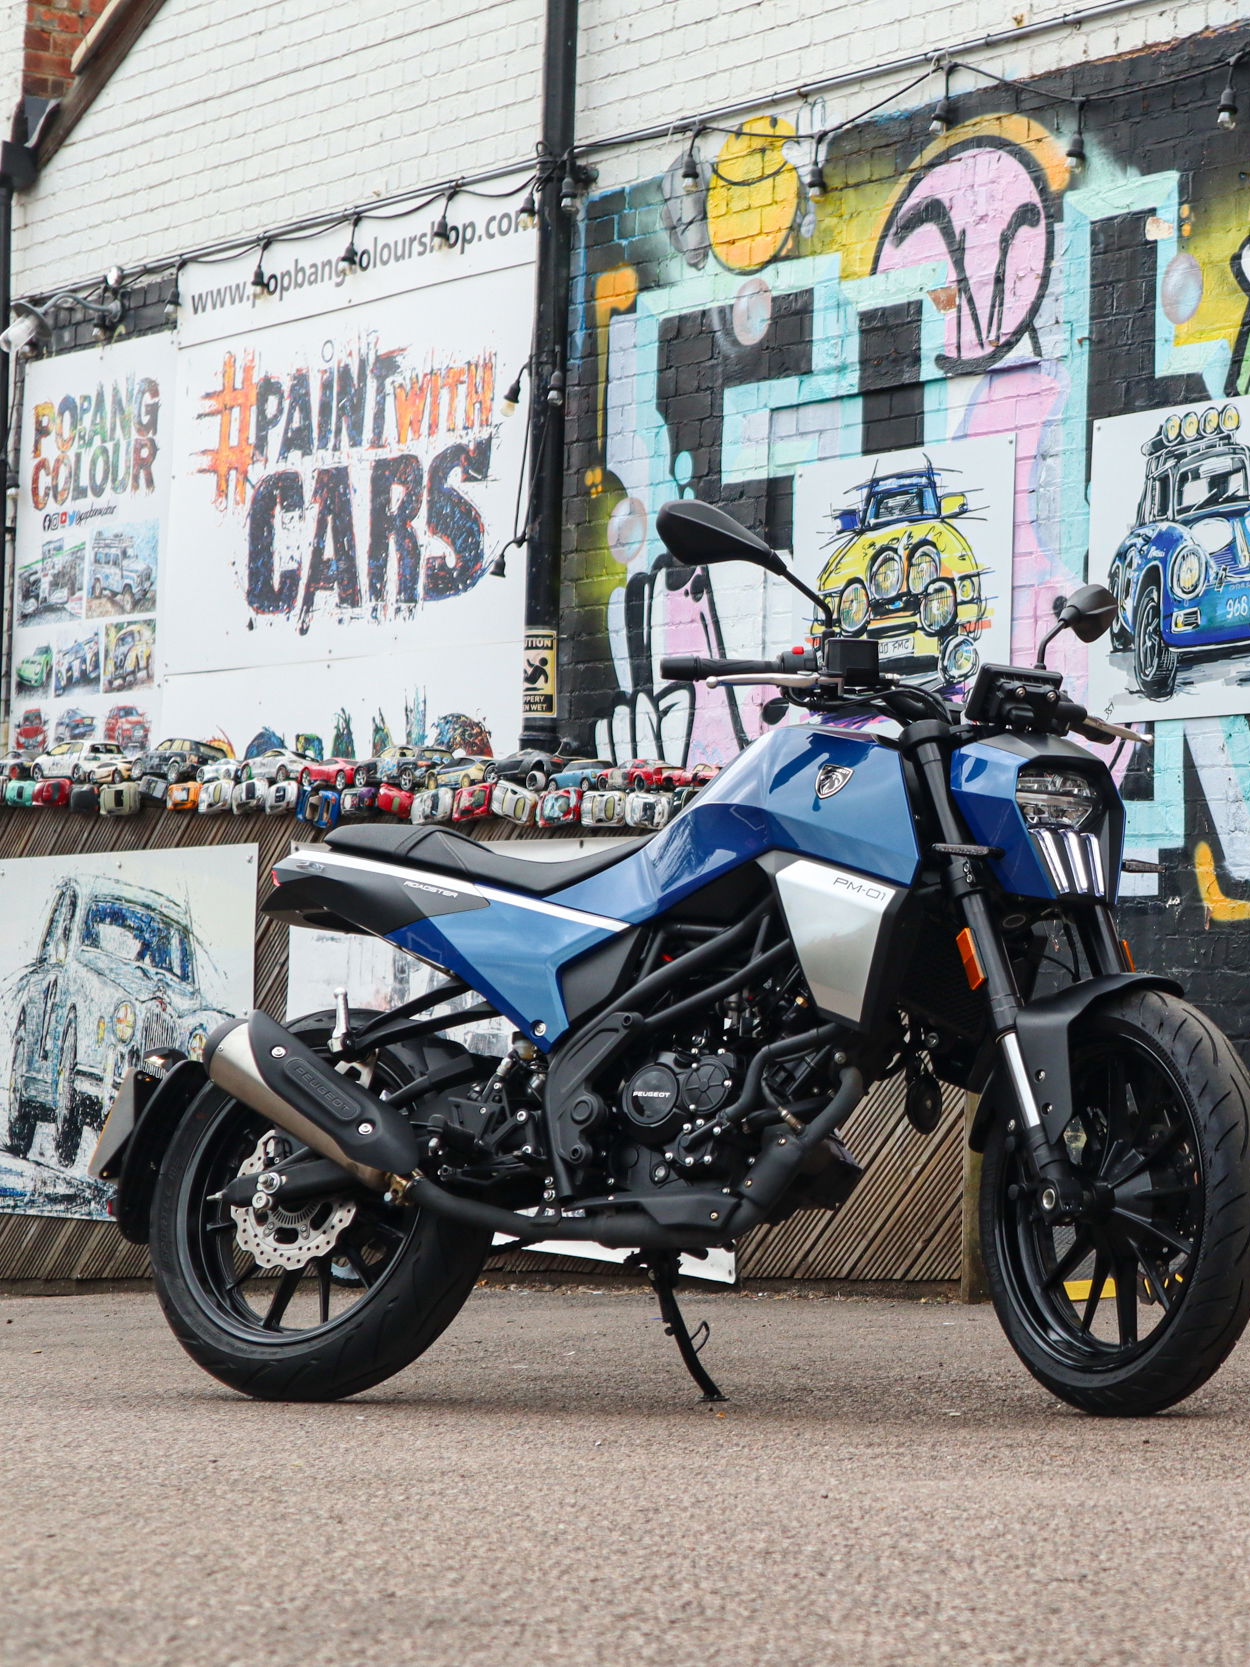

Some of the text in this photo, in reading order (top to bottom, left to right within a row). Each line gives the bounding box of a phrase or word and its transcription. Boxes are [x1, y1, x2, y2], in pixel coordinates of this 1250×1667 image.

[191, 208, 537, 315] www.opbangolourshop.co
[392, 350, 498, 446] WITH
[31, 437, 159, 511] COLOUR
[245, 436, 494, 628] CARS
[530, 703, 548, 711] WET
[403, 880, 459, 899] ROADSTER
[832, 877, 887, 901] PM-01
[295, 1066, 351, 1111] PEUGEOT
[632, 1090, 671, 1098] PEUGEOT
